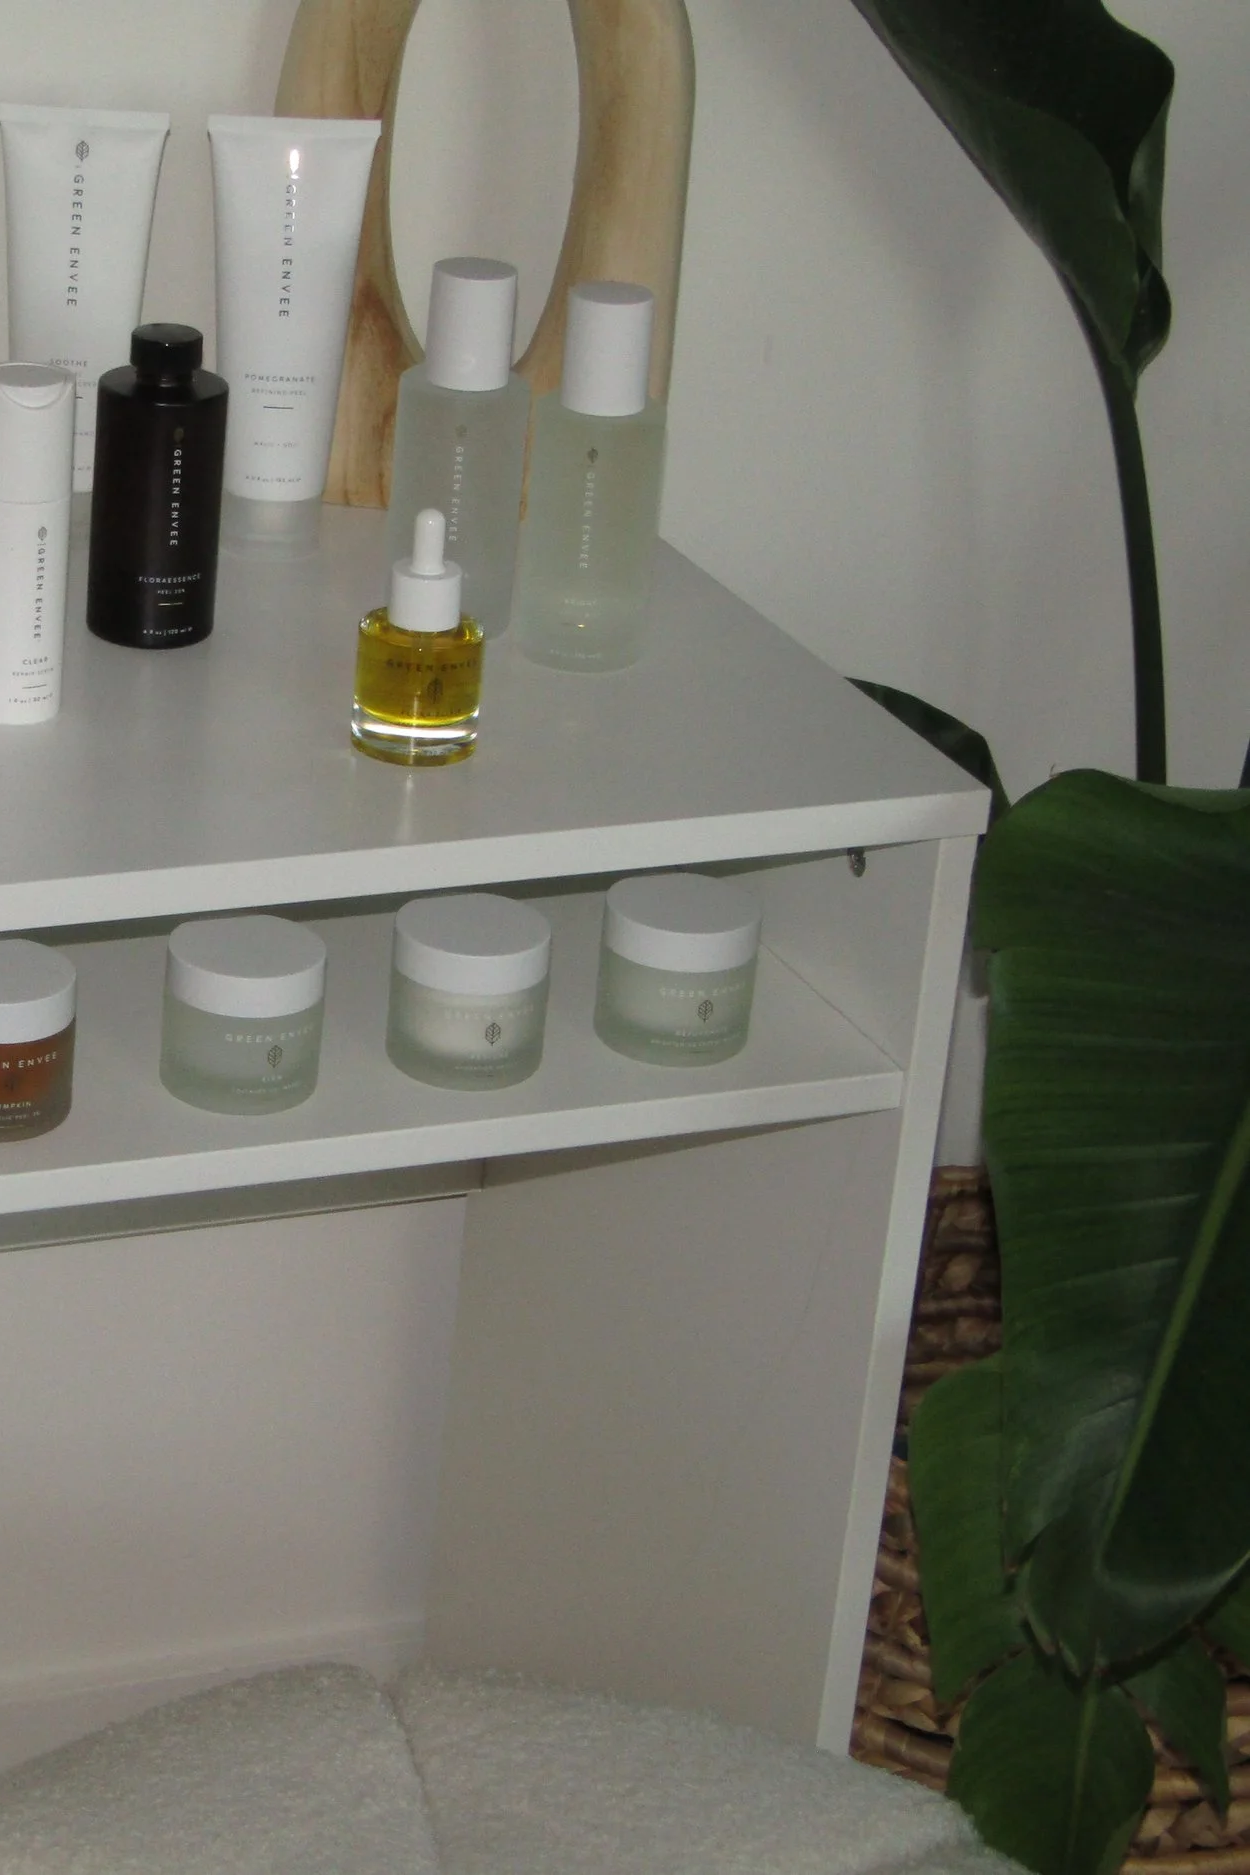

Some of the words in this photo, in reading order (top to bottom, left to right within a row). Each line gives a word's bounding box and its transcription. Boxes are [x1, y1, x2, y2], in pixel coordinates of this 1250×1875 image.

[70, 173, 85, 236] GREEN
[282, 183, 297, 247] GREEN
[66, 246, 81, 307] ENVEE
[278, 257, 294, 318] ENVEE
[244, 372, 316, 385] POMEGRANATE
[172, 448, 183, 495] GREEN
[452, 445, 465, 492] GREEN
[169, 501, 180, 547] ENVEE
[36, 547, 46, 592] GREEN
[138, 573, 202, 584] FLORAESSENCE
[33, 597, 44, 641] ENVEE
[22, 656, 49, 666] CLEAR
[18, 1051, 58, 1069] ENVEE
